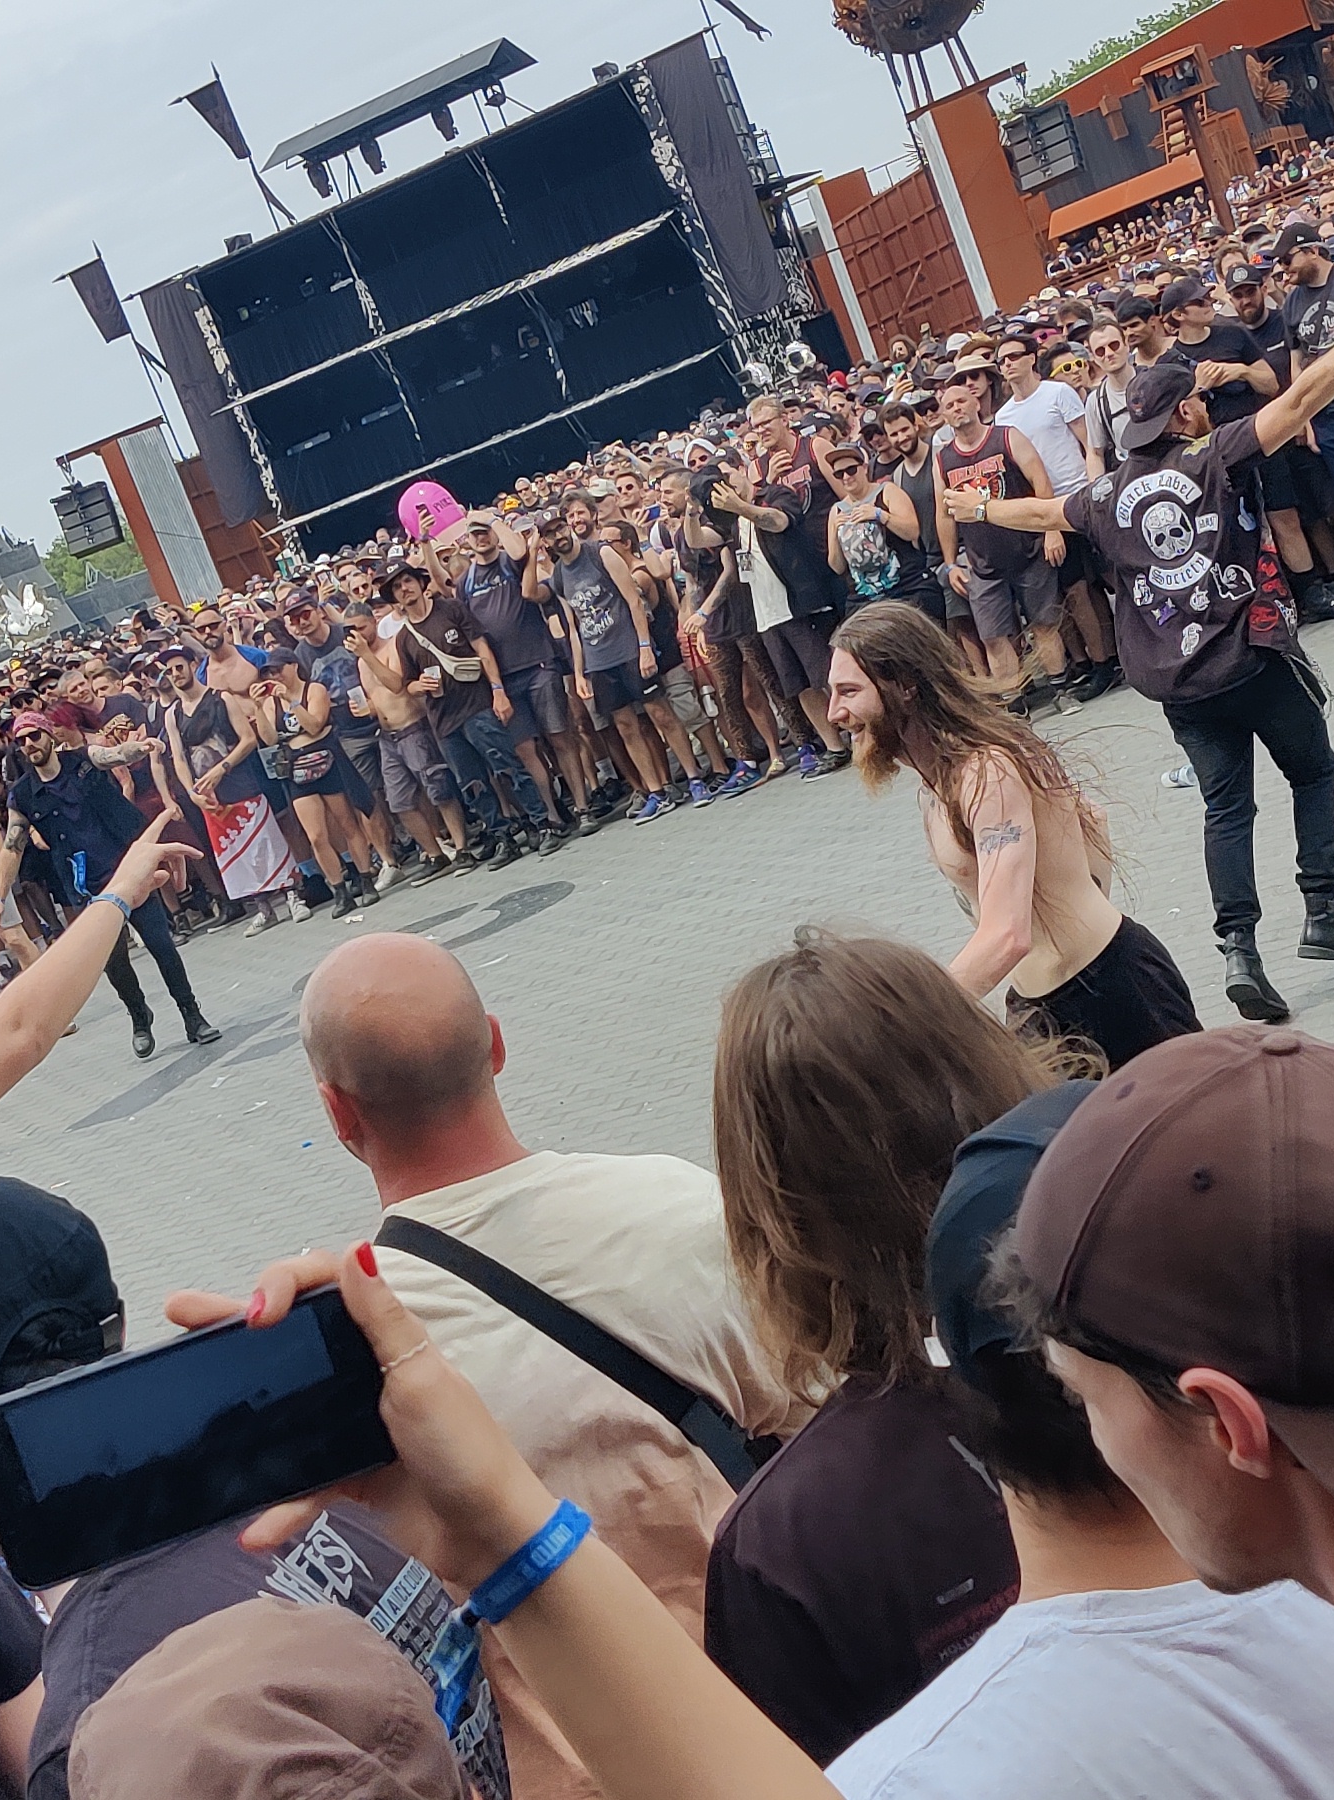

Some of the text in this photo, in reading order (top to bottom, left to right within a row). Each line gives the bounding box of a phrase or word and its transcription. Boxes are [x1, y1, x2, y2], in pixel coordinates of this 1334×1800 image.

[1119, 474, 1195, 522] Black Label
[1151, 556, 1206, 586] Society
